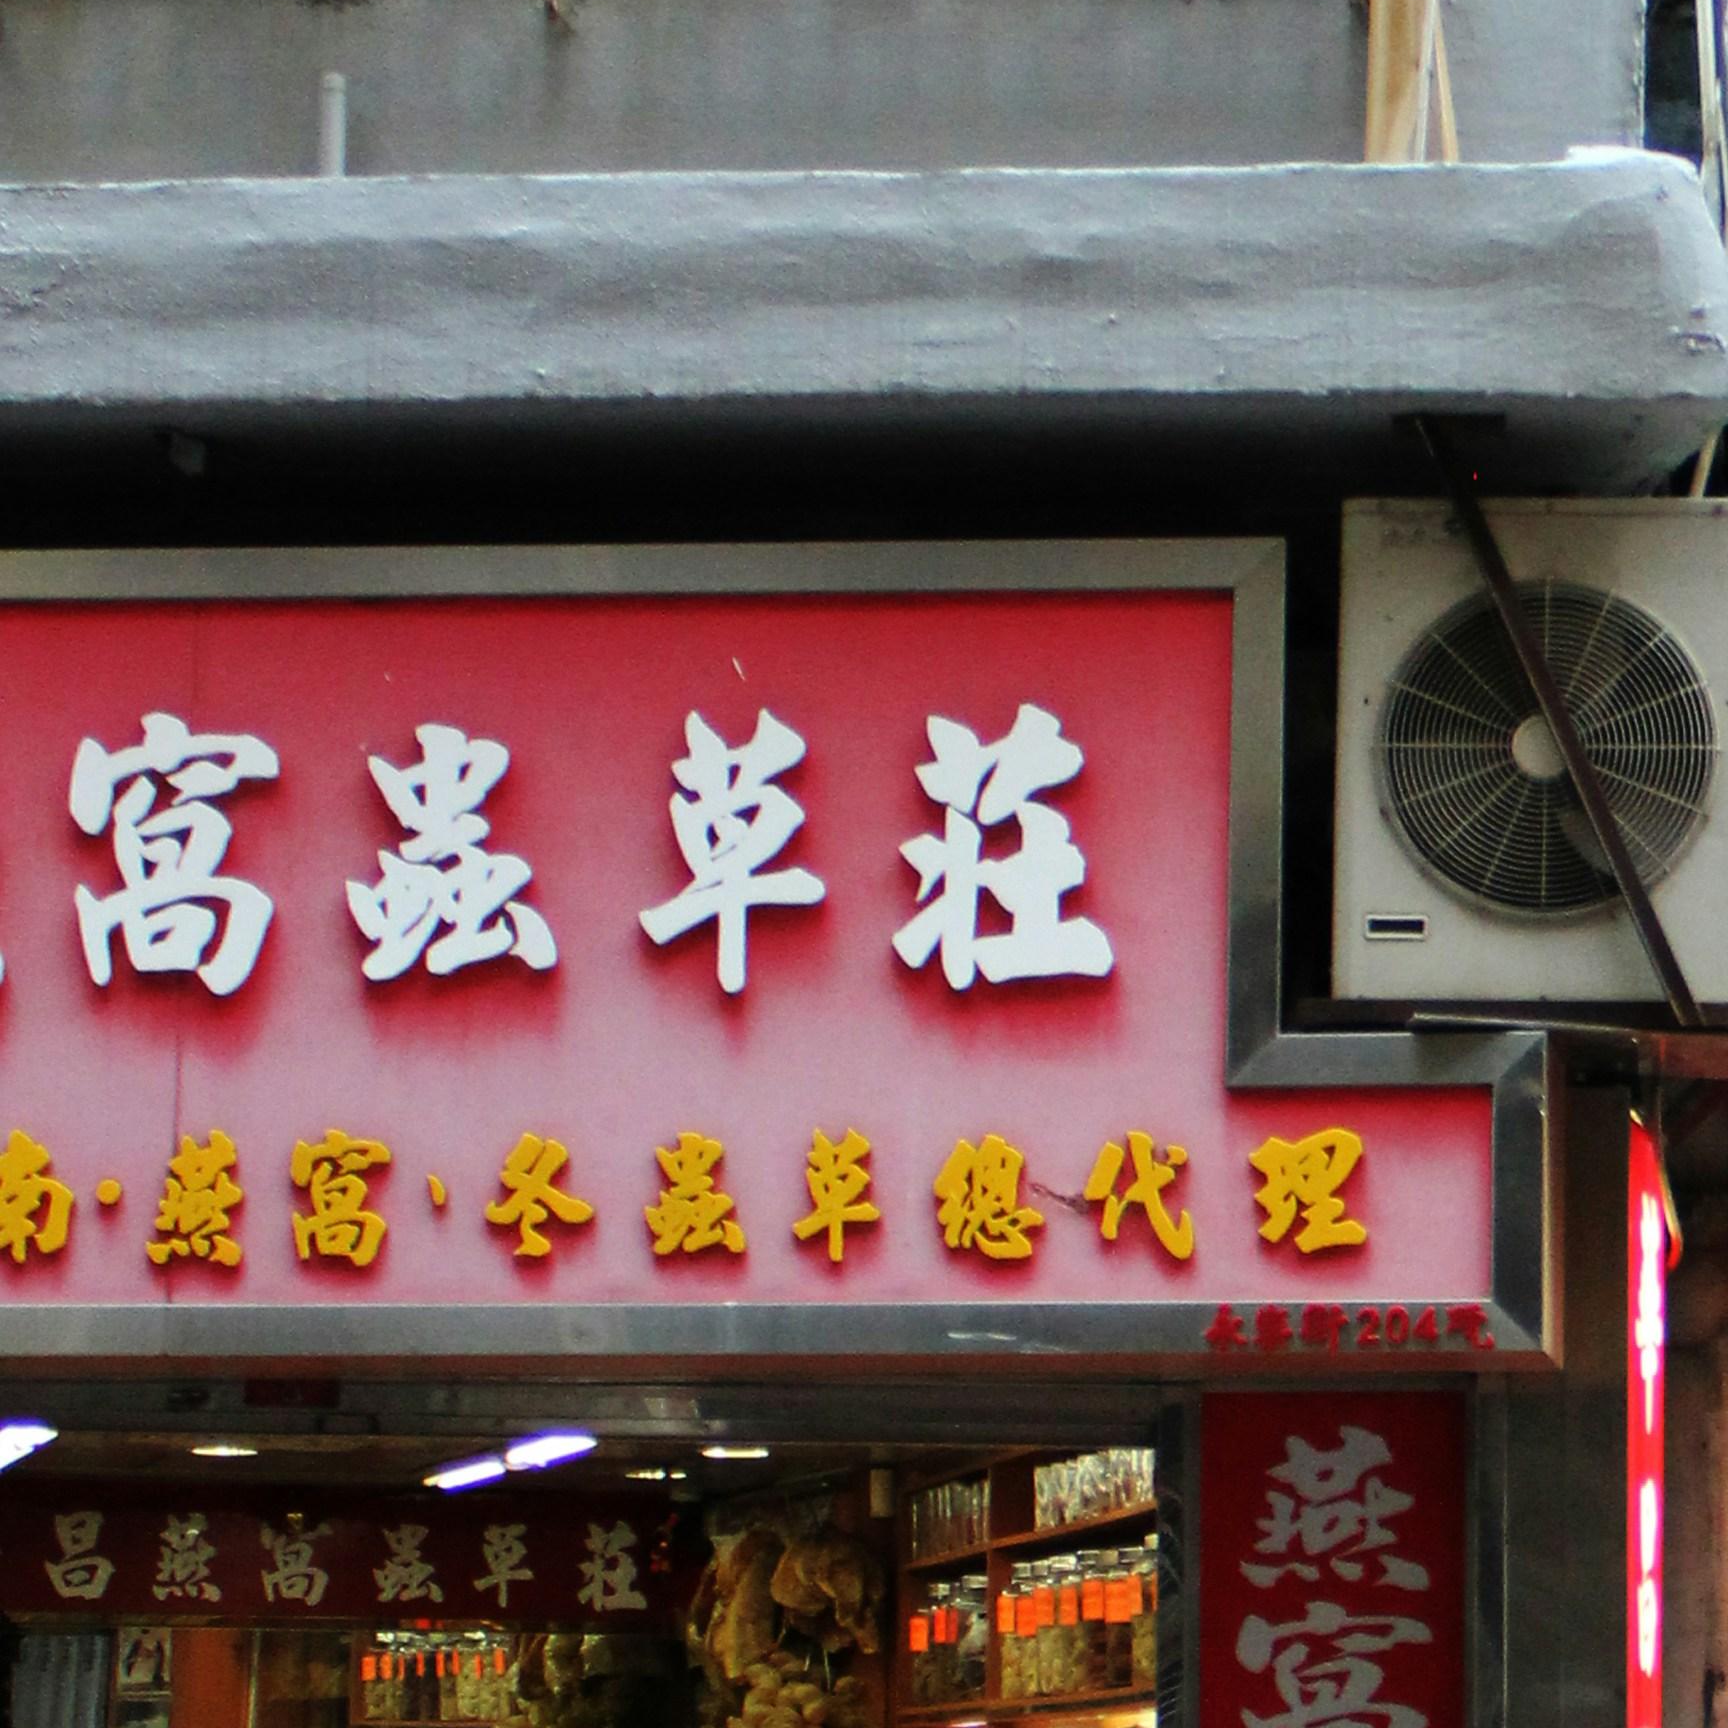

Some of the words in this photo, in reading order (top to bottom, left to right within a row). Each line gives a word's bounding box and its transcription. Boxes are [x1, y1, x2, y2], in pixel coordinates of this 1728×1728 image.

[44, 1509, 648, 1612] 昌燕窩蟲草莊
